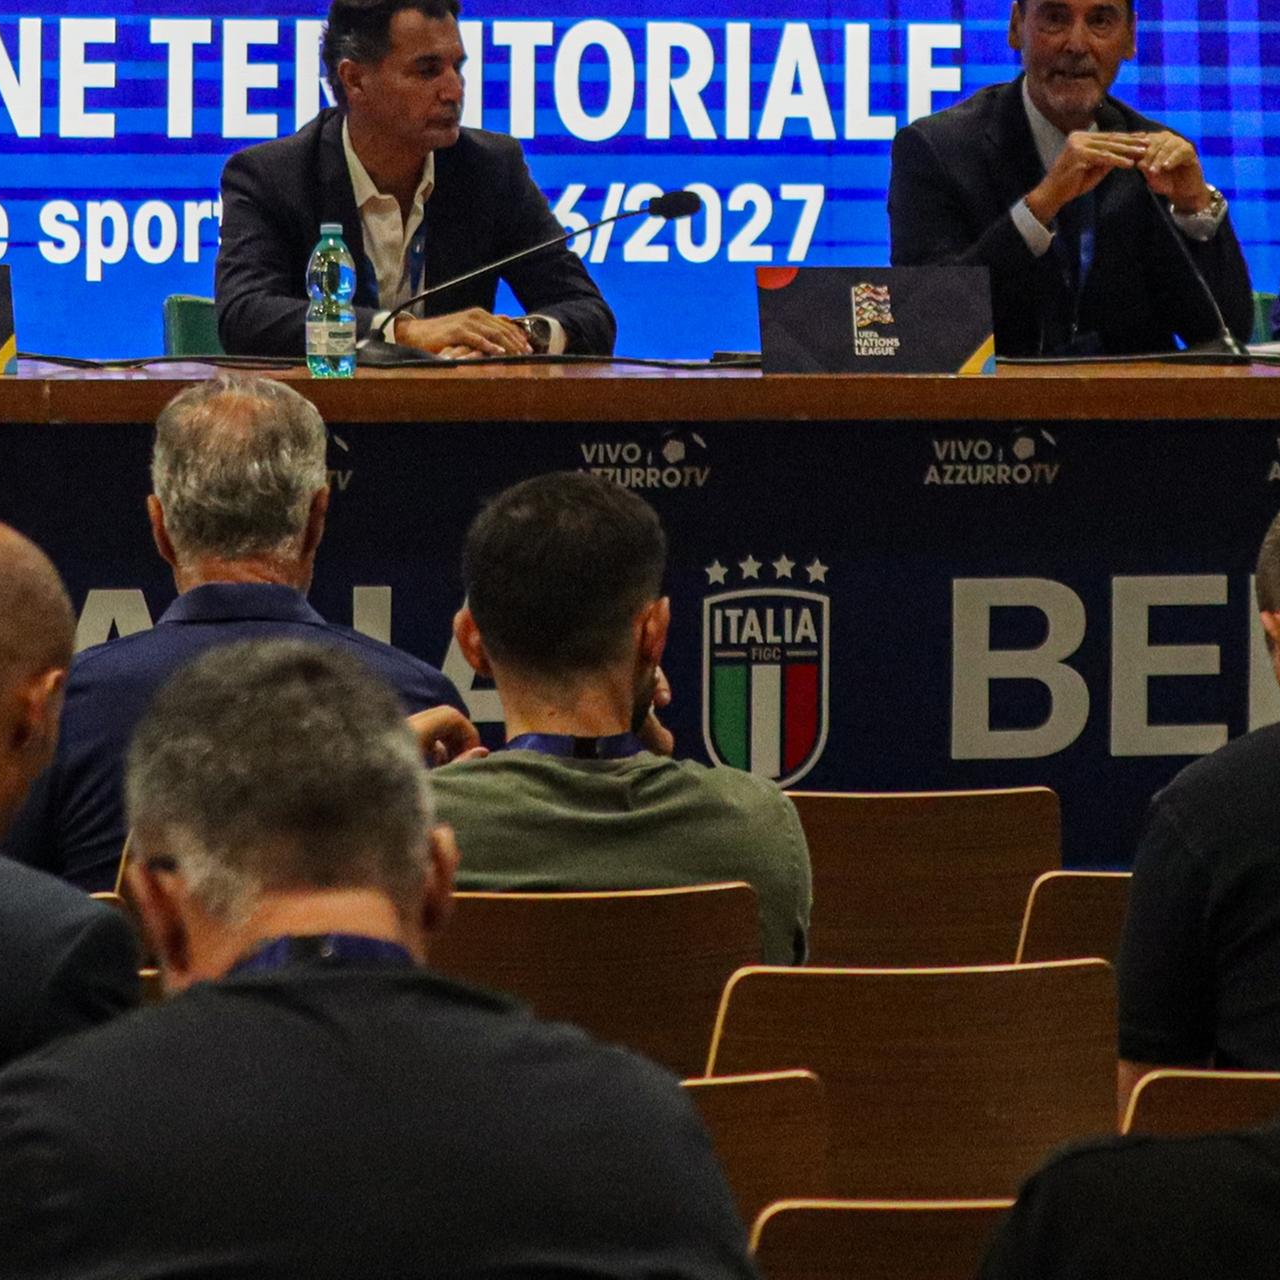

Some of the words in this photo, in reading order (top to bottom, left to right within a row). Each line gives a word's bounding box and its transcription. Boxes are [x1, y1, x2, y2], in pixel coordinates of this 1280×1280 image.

[855, 337, 901, 347] NATIONS
[855, 347, 896, 356] LEAGUE
[580, 442, 642, 464] VIVO
[933, 439, 993, 461] VIVO
[714, 607, 818, 644] ITALIA
[751, 646, 782, 661] FIGC
